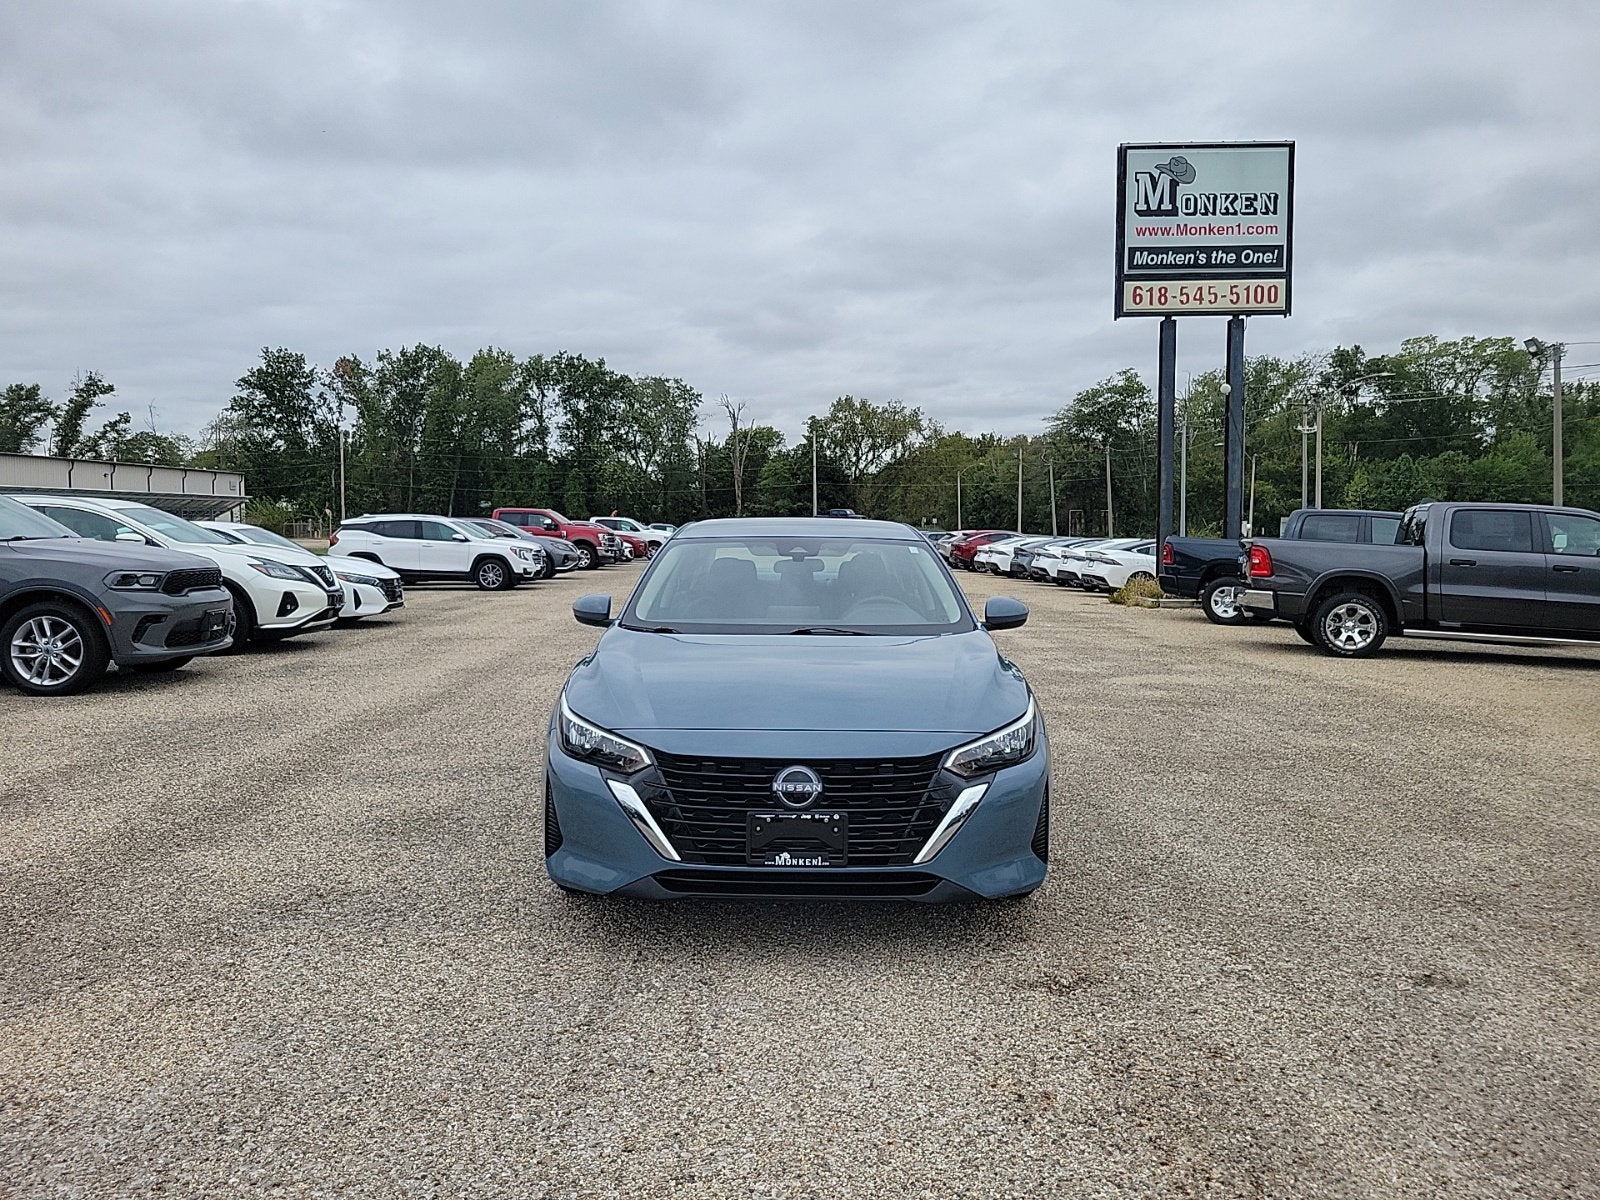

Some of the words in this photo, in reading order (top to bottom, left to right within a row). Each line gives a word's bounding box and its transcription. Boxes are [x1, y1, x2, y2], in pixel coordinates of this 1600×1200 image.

[1134, 172, 1279, 217] MONKEN
[1135, 223, 1278, 236] www.Monken1.com
[1133, 250, 1207, 265] Monken's
[1211, 250, 1237, 264] the
[1241, 249, 1279, 264] One!
[1132, 284, 1279, 305] 618-545-5100
[773, 783, 822, 792] NISSAN
